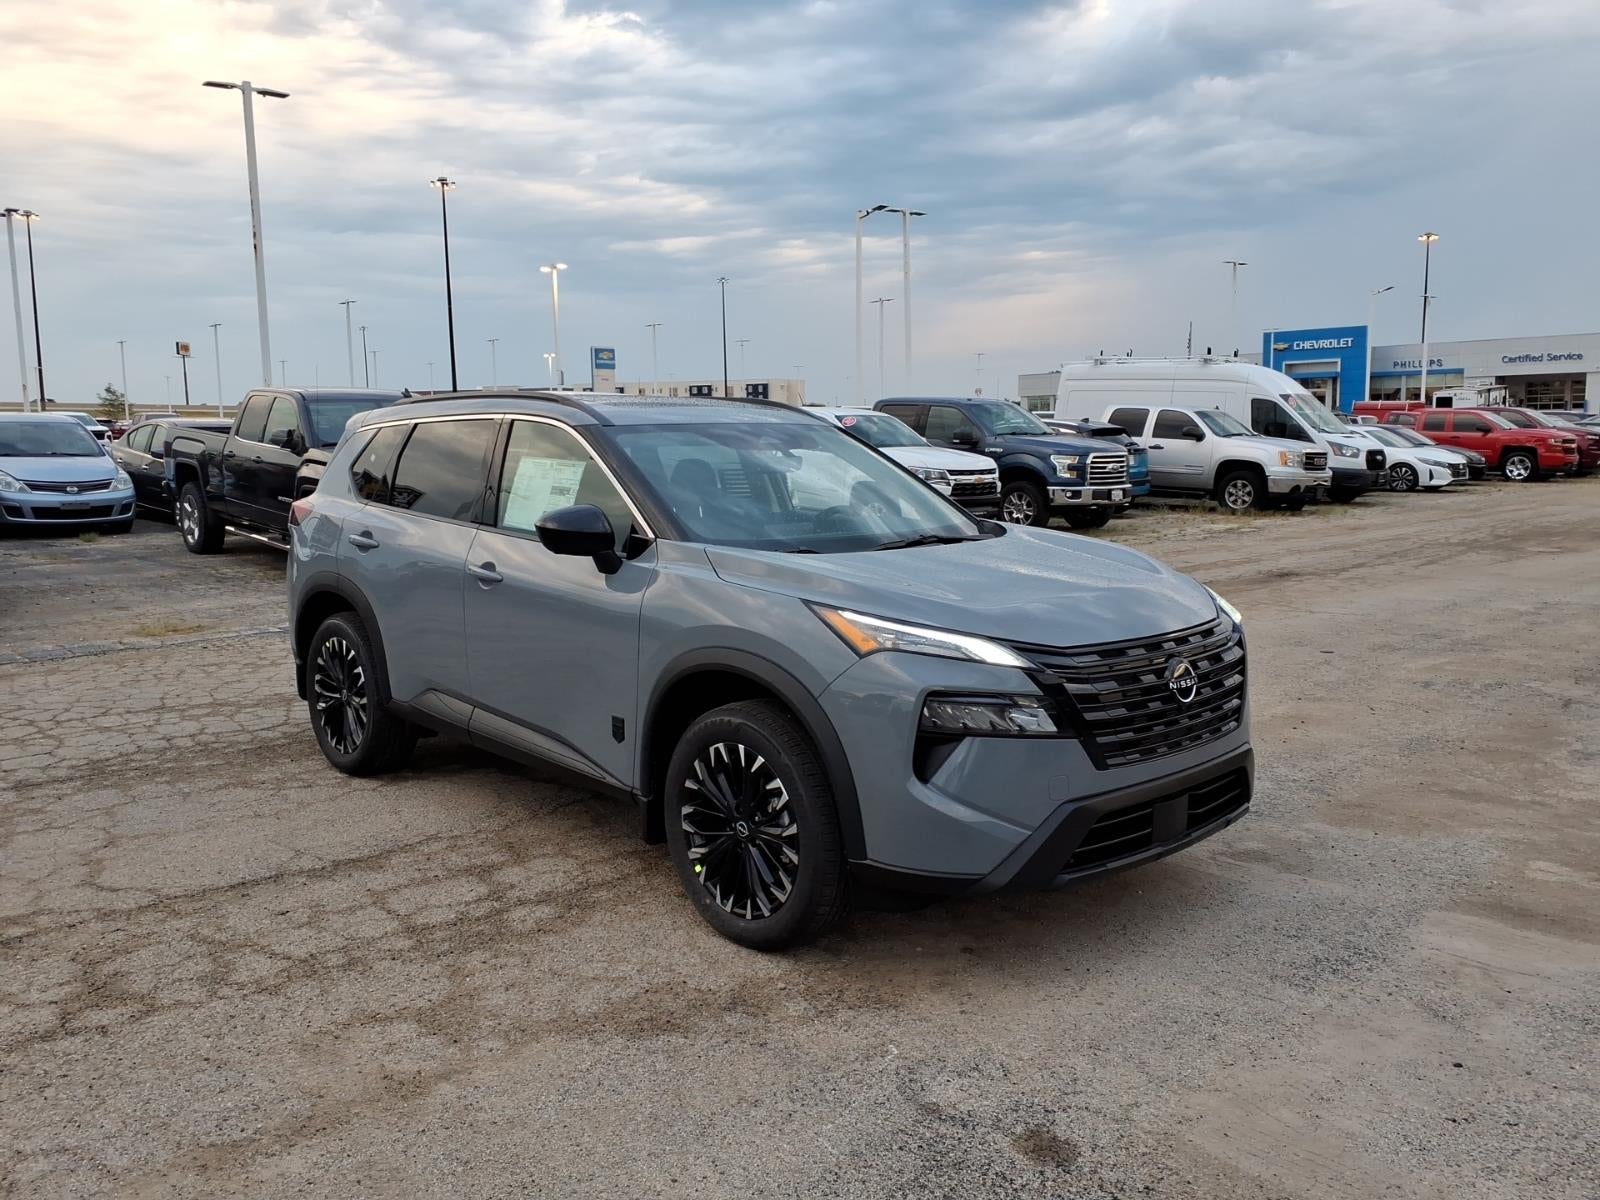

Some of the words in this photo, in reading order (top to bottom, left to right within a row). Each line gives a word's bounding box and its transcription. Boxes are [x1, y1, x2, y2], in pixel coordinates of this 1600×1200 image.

[1293, 337, 1354, 351] CHEVROLET
[1393, 358, 1443, 369] PHILLPS
[1501, 353, 1544, 364] Certified
[1546, 352, 1584, 362] Service
